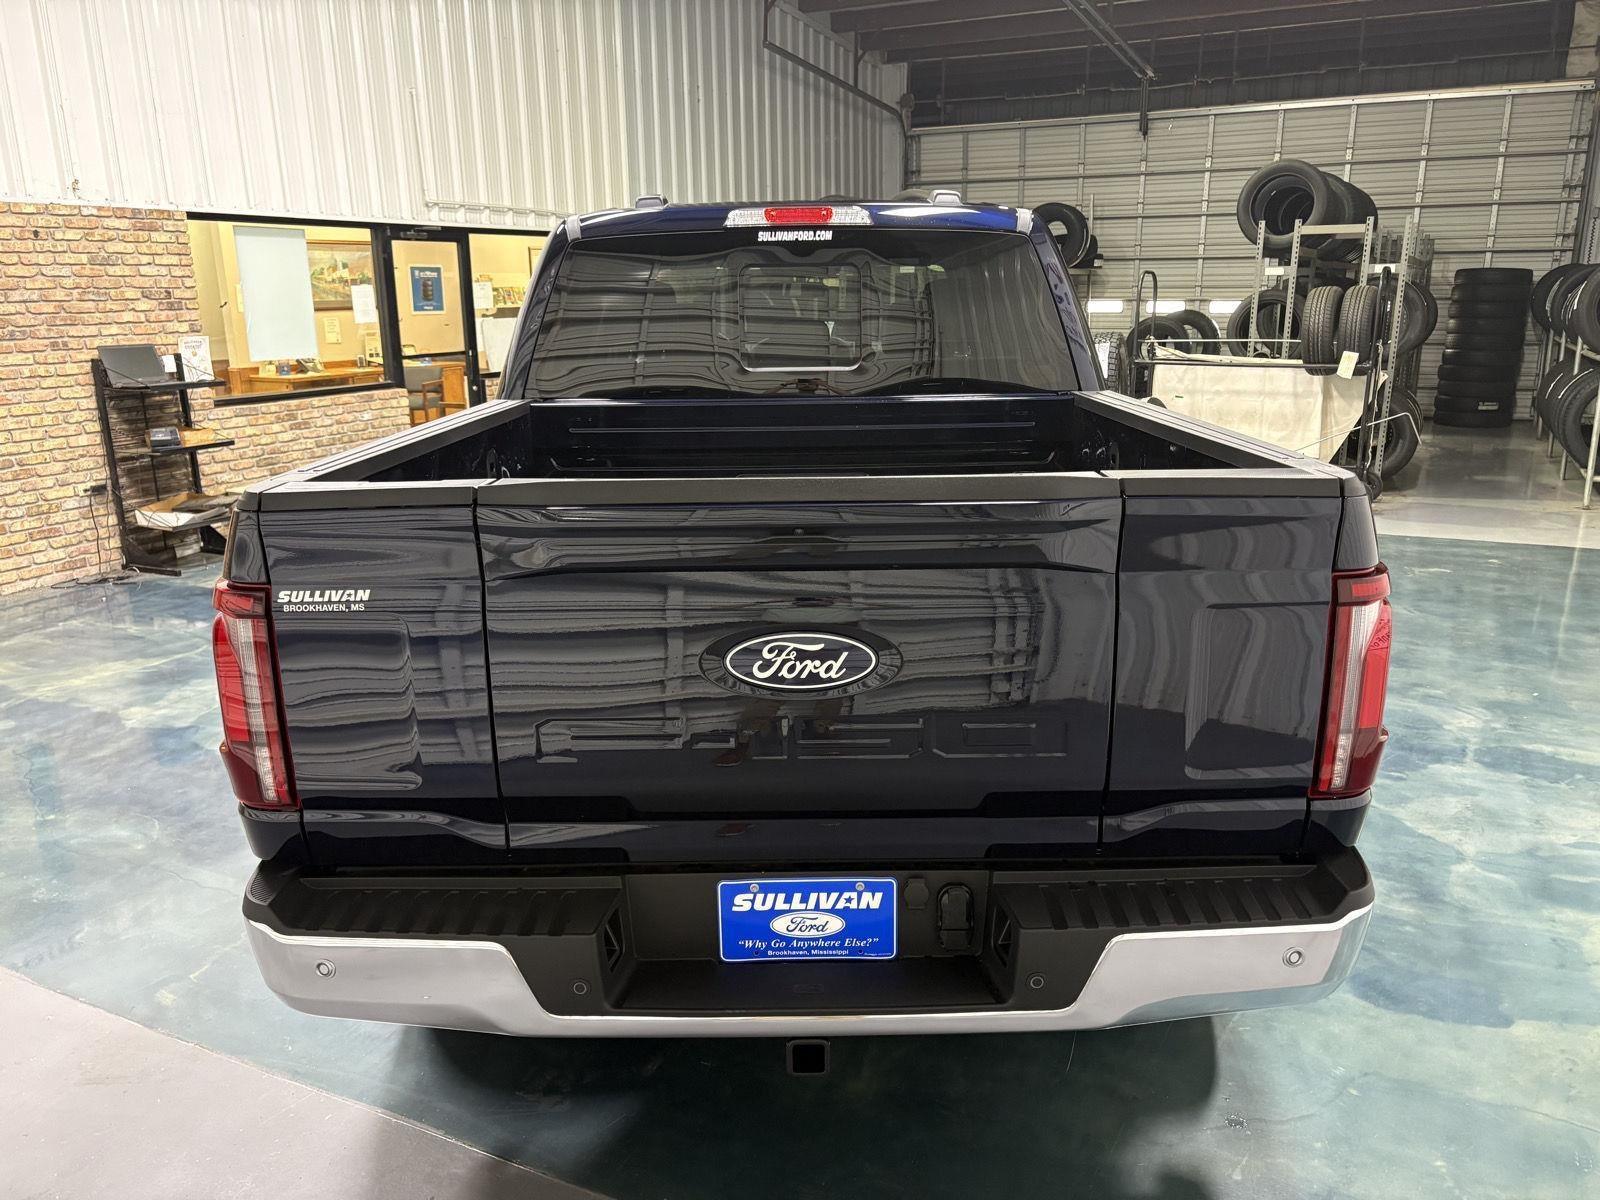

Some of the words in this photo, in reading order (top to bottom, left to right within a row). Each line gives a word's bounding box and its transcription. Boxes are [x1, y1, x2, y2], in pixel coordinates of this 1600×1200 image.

[757, 231, 833, 241] SULLIVANFORD.COM
[277, 589, 370, 603] SULLIVAN
[283, 604, 348, 612] BROOKHAVEN,
[350, 603, 365, 611] MS
[752, 641, 849, 679] Ford
[731, 891, 883, 912] SULLIVAN
[785, 916, 829, 933] Ford
[771, 939, 786, 948] Go
[788, 938, 841, 948] Anywhere
